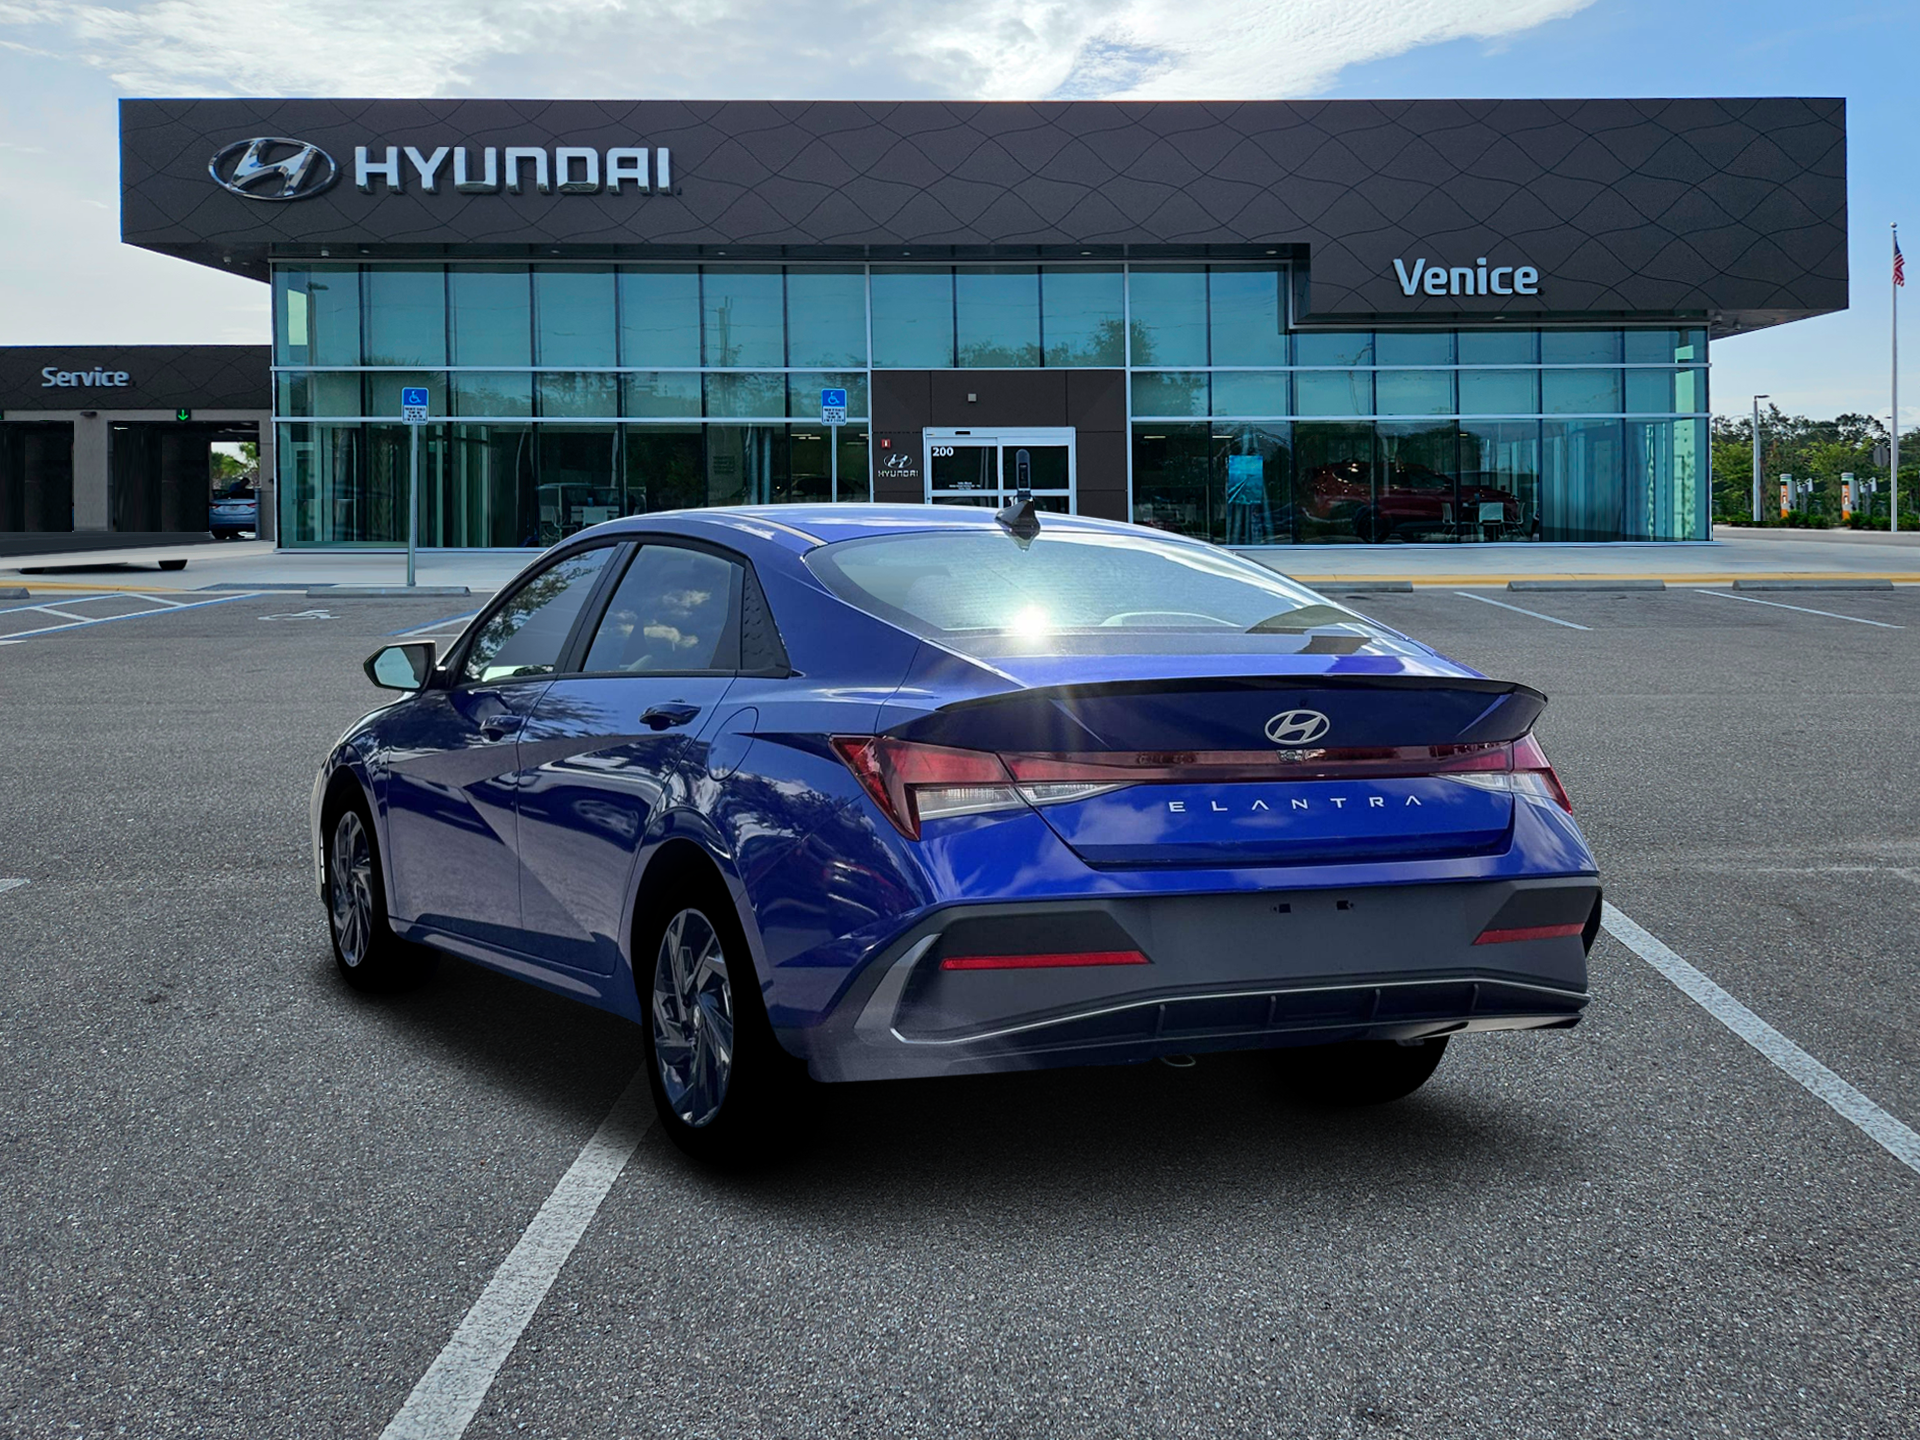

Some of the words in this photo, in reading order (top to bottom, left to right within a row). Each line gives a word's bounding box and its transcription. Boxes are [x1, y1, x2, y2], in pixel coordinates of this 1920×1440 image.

[354, 146, 671, 193] HYUNDAI
[1393, 257, 1539, 296] Venice
[41, 367, 130, 387] Service
[932, 446, 954, 456] 200
[877, 469, 919, 477] HYUNDAI
[1169, 795, 1422, 812] ELANTRA
